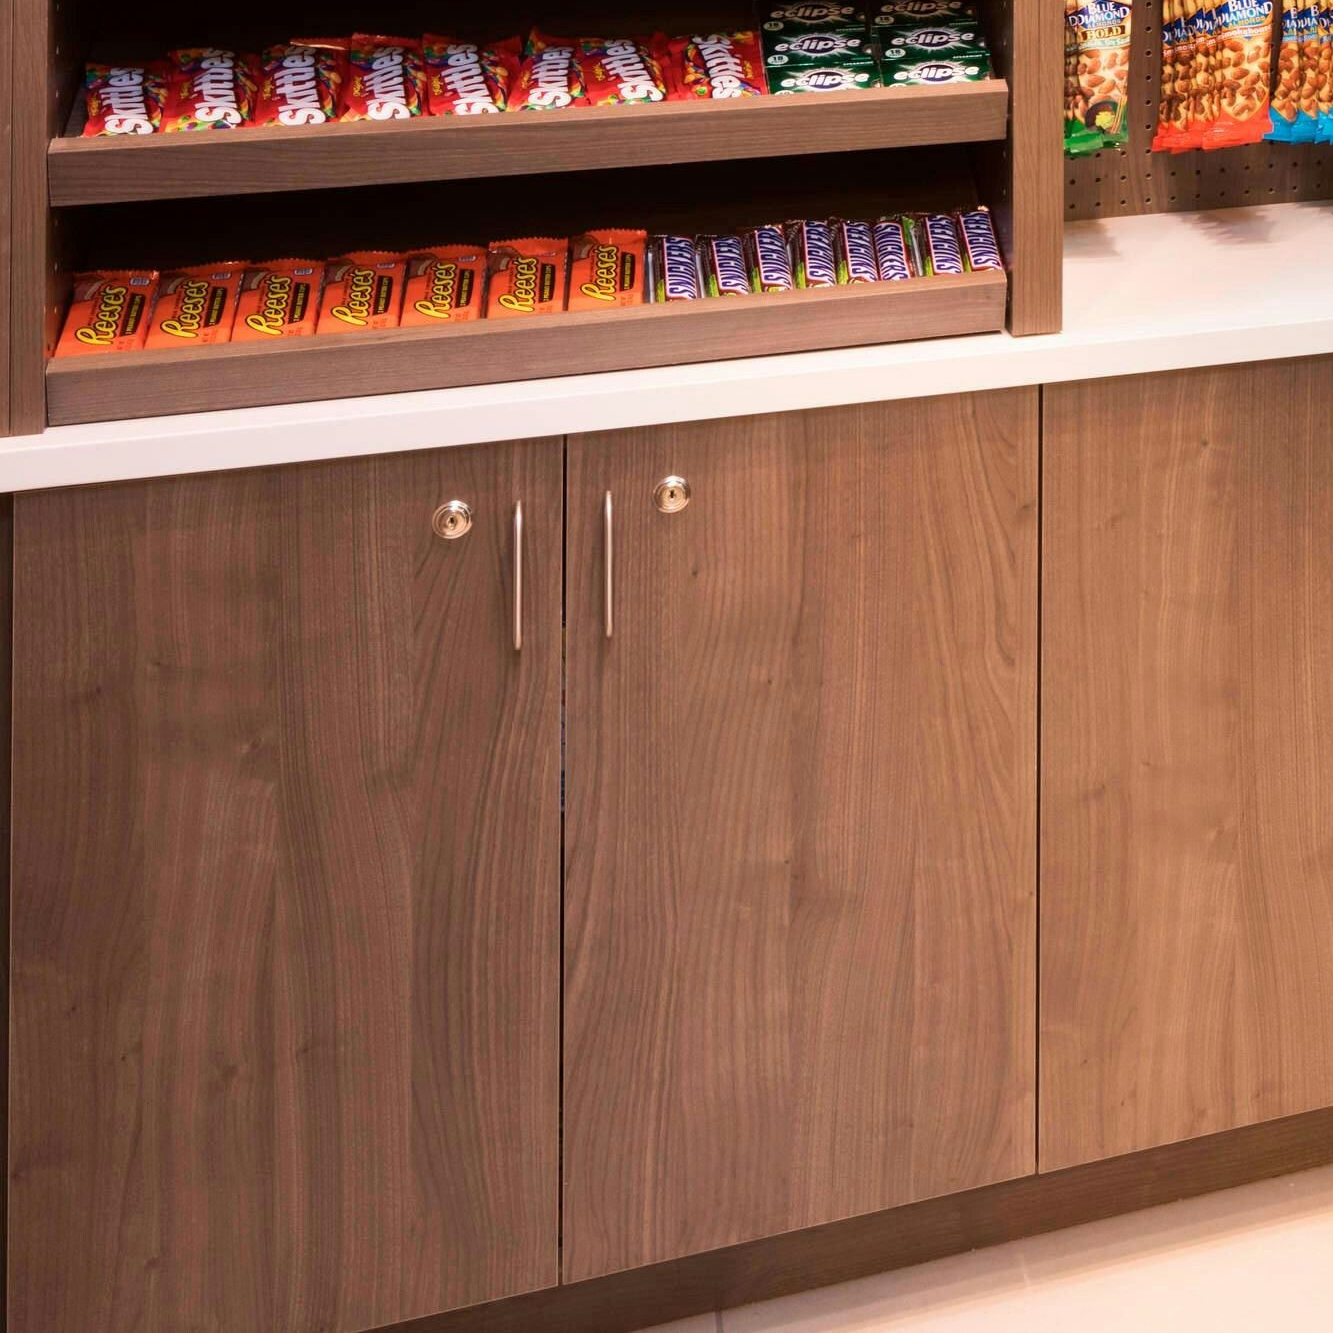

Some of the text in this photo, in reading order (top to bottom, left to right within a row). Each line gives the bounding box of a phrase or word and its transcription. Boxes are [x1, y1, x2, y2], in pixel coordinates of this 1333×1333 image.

[769, 3, 855, 22] eclipse
[1088, 2, 1118, 15] BLUE
[1088, 26, 1121, 39] BOLD
[691, 33, 741, 99] Skittles
[775, 33, 862, 54] eclipse
[891, 29, 975, 51] eclipse
[195, 47, 242, 123] Skittles
[279, 43, 326, 125] Skittles
[364, 47, 410, 120] Skittles
[443, 43, 499, 116] Skittles
[601, 38, 665, 101] Skittles
[781, 69, 869, 91] eclipse
[893, 64, 980, 84] eclipse
[105, 67, 154, 135] Skittles
[330, 269, 374, 326] Reese's
[413, 262, 456, 319] Reese's
[498, 257, 538, 312] Reese's
[581, 244, 618, 302] Reese's
[75, 285, 127, 345] Reese's
[161, 279, 209, 338] Reese's
[245, 275, 291, 336] Reese's
